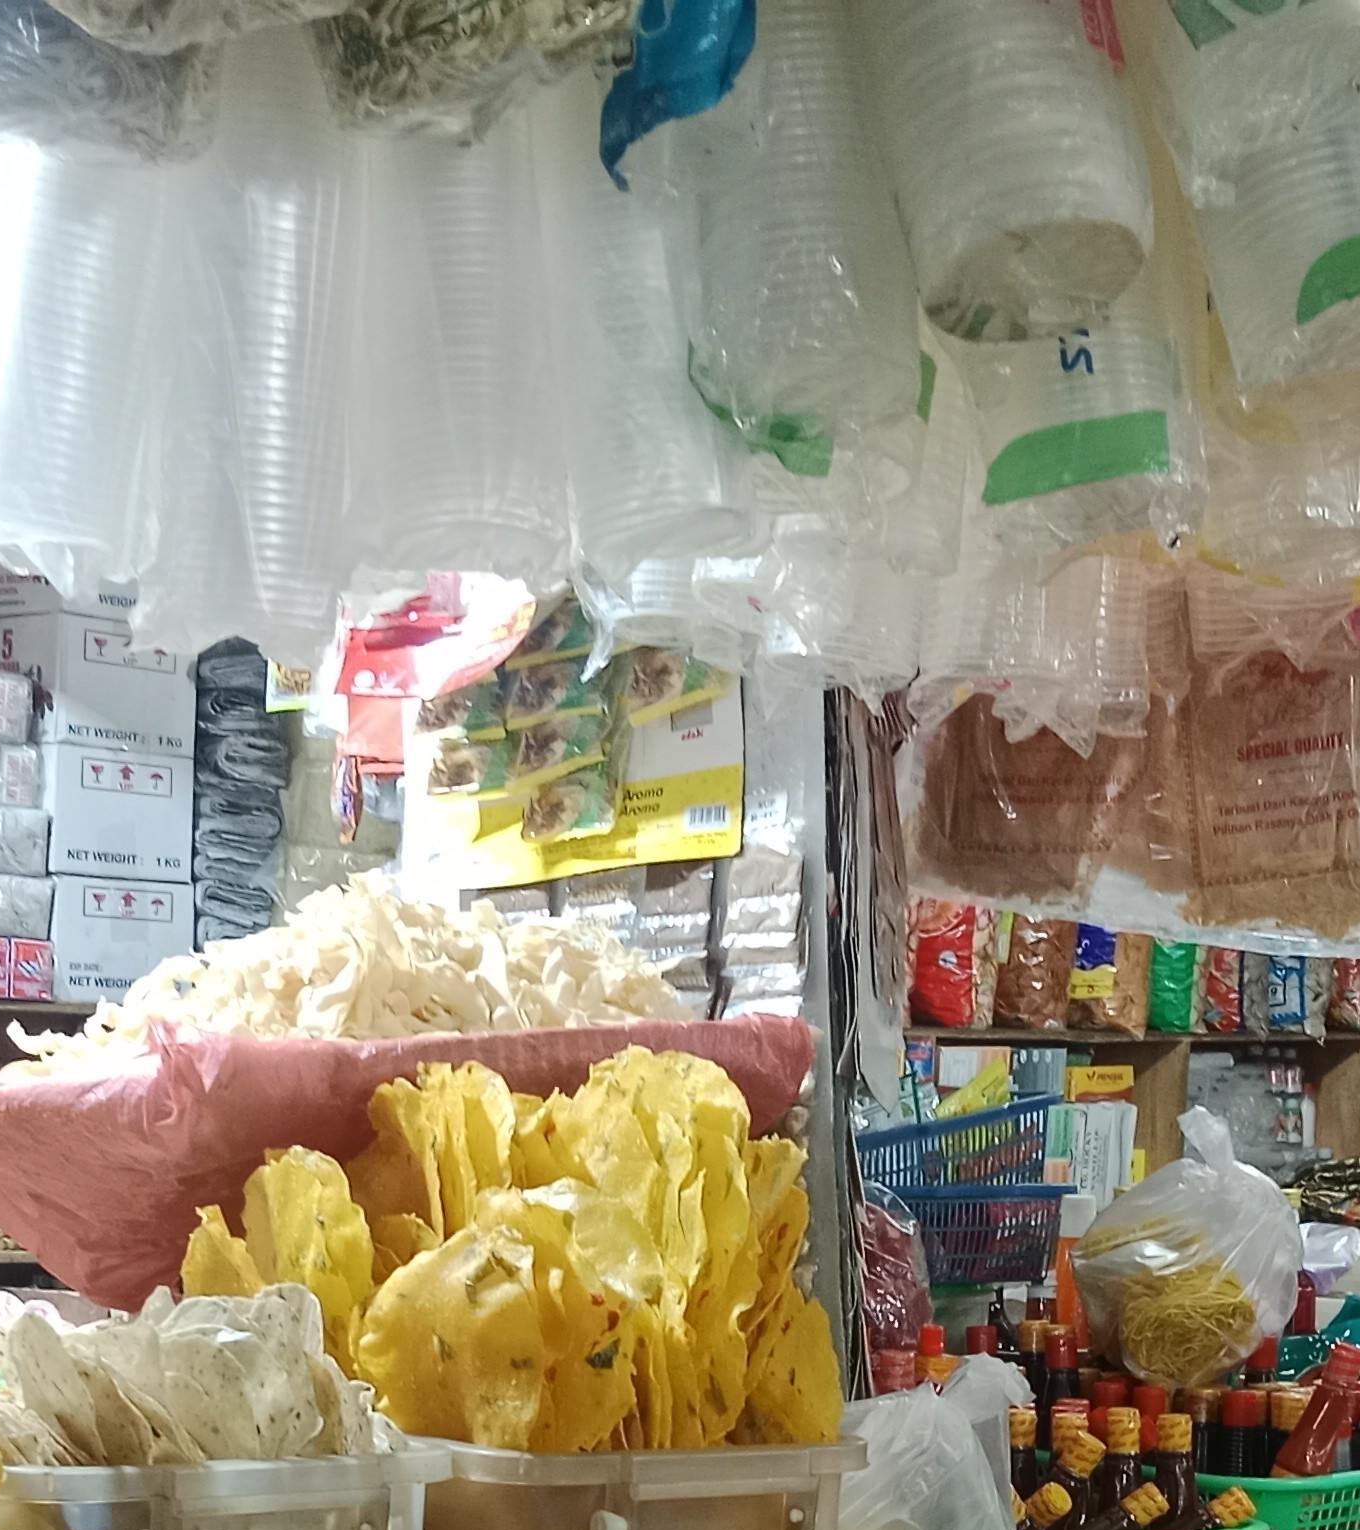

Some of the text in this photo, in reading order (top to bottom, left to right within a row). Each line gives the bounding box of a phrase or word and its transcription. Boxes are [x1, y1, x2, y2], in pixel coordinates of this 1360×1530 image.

[98, 593, 138, 607] WEIGH
[1, 629, 14, 660] 5
[68, 724, 90, 735] NET
[94, 727, 139, 742] WEIGHT
[166, 738, 183, 747] KG
[1237, 732, 1343, 762] SPECIAL QUALITY
[624, 787, 664, 802] Aroma
[620, 802, 661, 816] Aroma
[67, 849, 90, 860] NET
[93, 852, 138, 865] WEIGHT
[164, 858, 181, 868] KG
[69, 976, 134, 989] NET WEIGH
